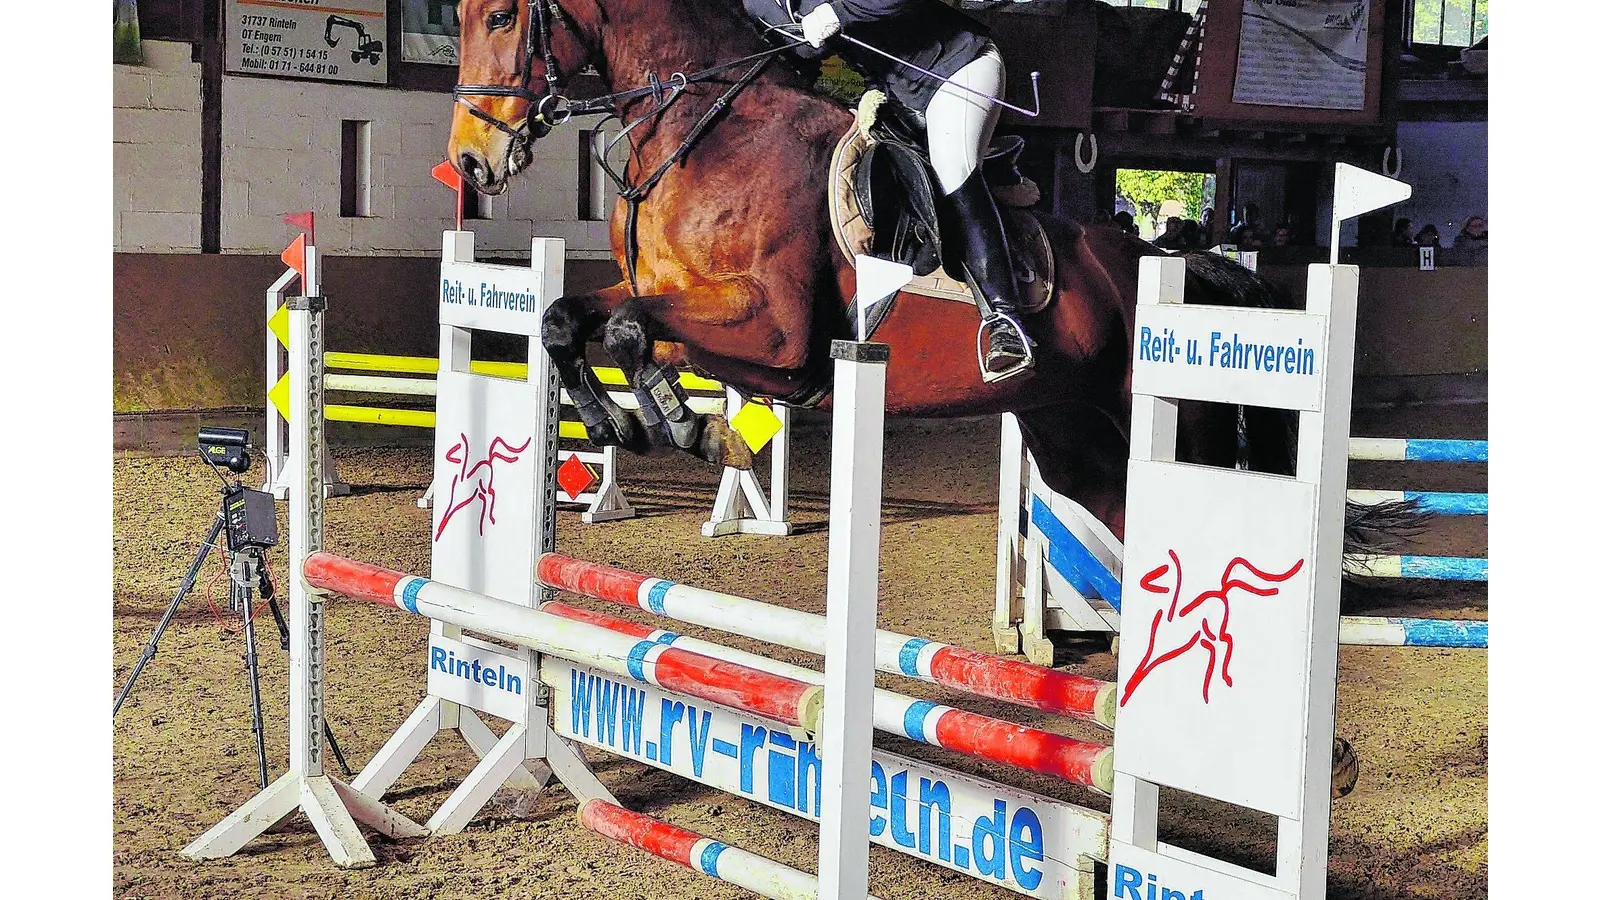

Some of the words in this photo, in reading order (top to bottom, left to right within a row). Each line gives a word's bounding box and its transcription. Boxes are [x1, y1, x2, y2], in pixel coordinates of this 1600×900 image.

[242, 15, 267, 26] 31737
[269, 17, 297, 30] Rinteln
[242, 29, 253, 40] OT
[254, 30, 282, 43] Engern
[242, 43, 258, 54] Tel.:
[260, 45, 270, 57] (0
[271, 46, 282, 56] 57
[283, 47, 297, 60] 51)
[305, 49, 316, 59] 54
[318, 50, 328, 60] 15
[241, 57, 268, 69] Mobil:
[269, 59, 279, 70] 01
[282, 60, 291, 71] 71
[299, 62, 315, 73] 644
[316, 63, 326, 74] 81
[328, 64, 339, 75] 00
[1423, 250, 1431, 267] H
[442, 279, 465, 305] Reit-
[468, 287, 477, 306] u.
[480, 282, 536, 313] Fahrverein
[1139, 326, 1181, 364] Reit-
[1186, 339, 1202, 366] u.
[1209, 331, 1315, 376] Fahrverein
[431, 646, 521, 695] Rinteln
